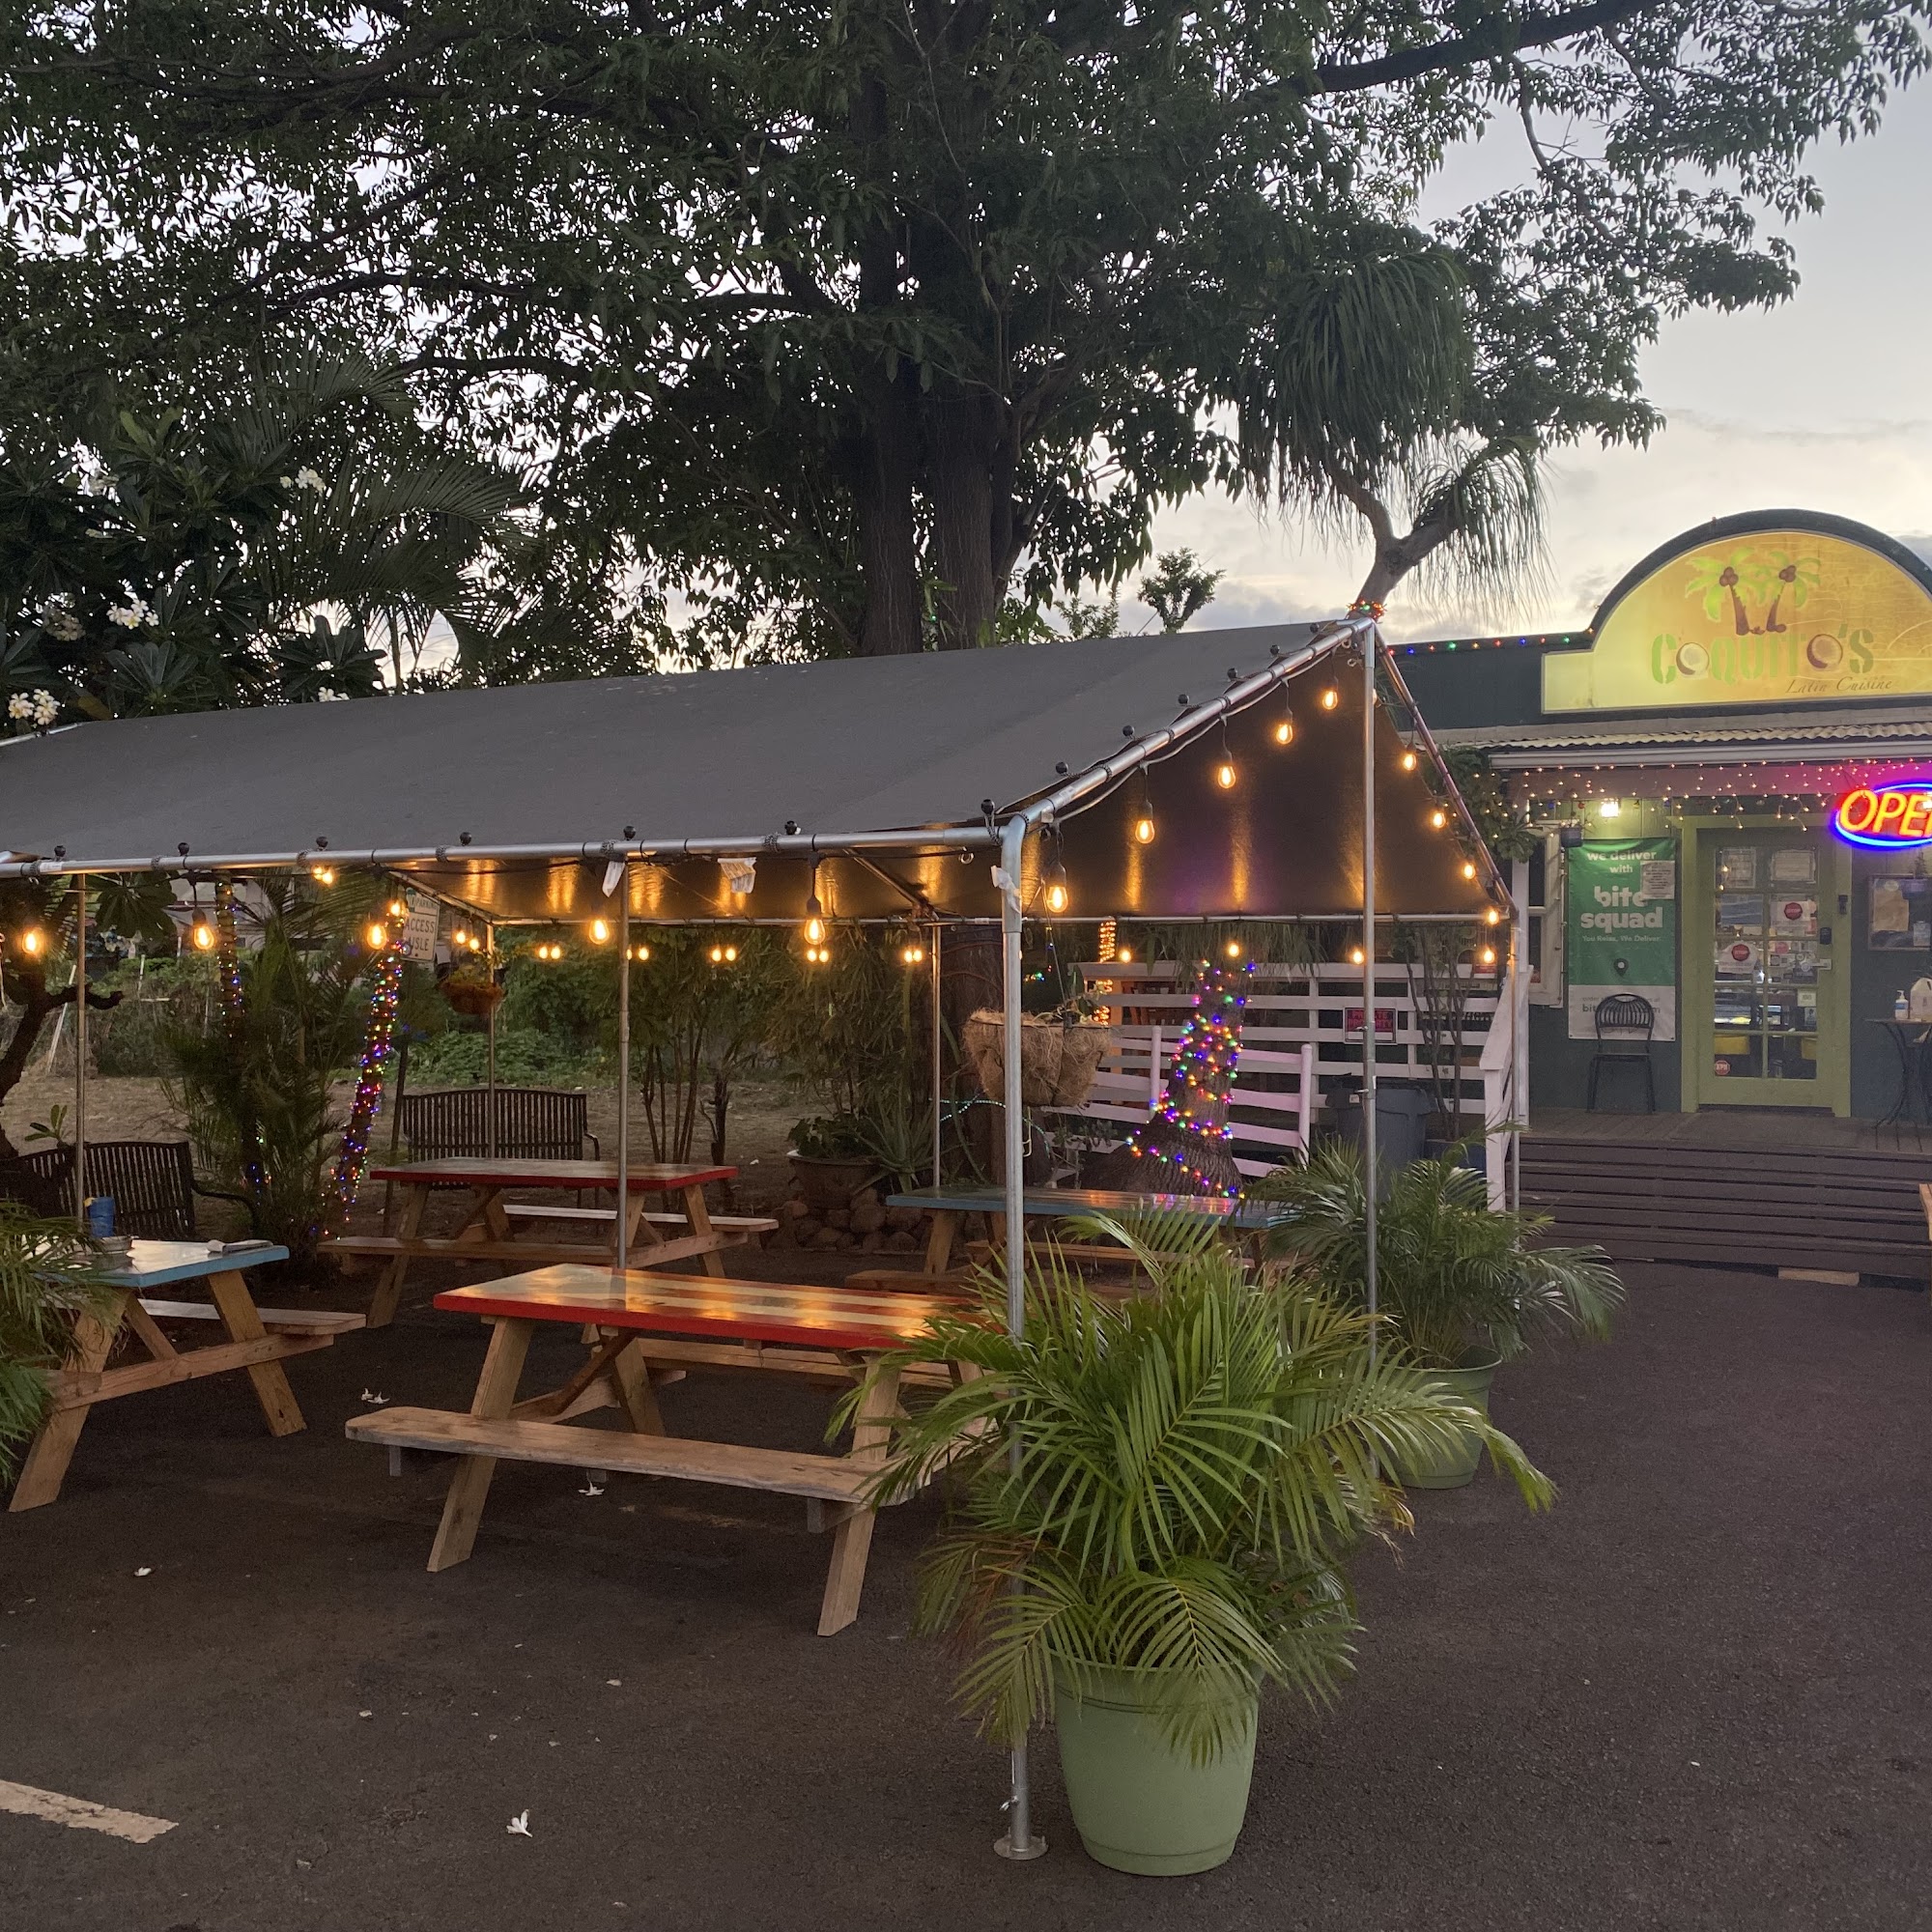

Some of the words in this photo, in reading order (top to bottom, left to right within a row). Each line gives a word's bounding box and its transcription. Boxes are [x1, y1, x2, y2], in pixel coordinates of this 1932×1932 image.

[1785, 679, 1829, 695] Latin
[1835, 675, 1893, 692] Cuisine
[1840, 789, 1932, 838] OPE
[1586, 851, 1606, 861] we
[1609, 849, 1658, 861] deliver
[1609, 864, 1634, 873] with
[405, 918, 436, 934] ACCESS
[1580, 906, 1662, 934] squad
